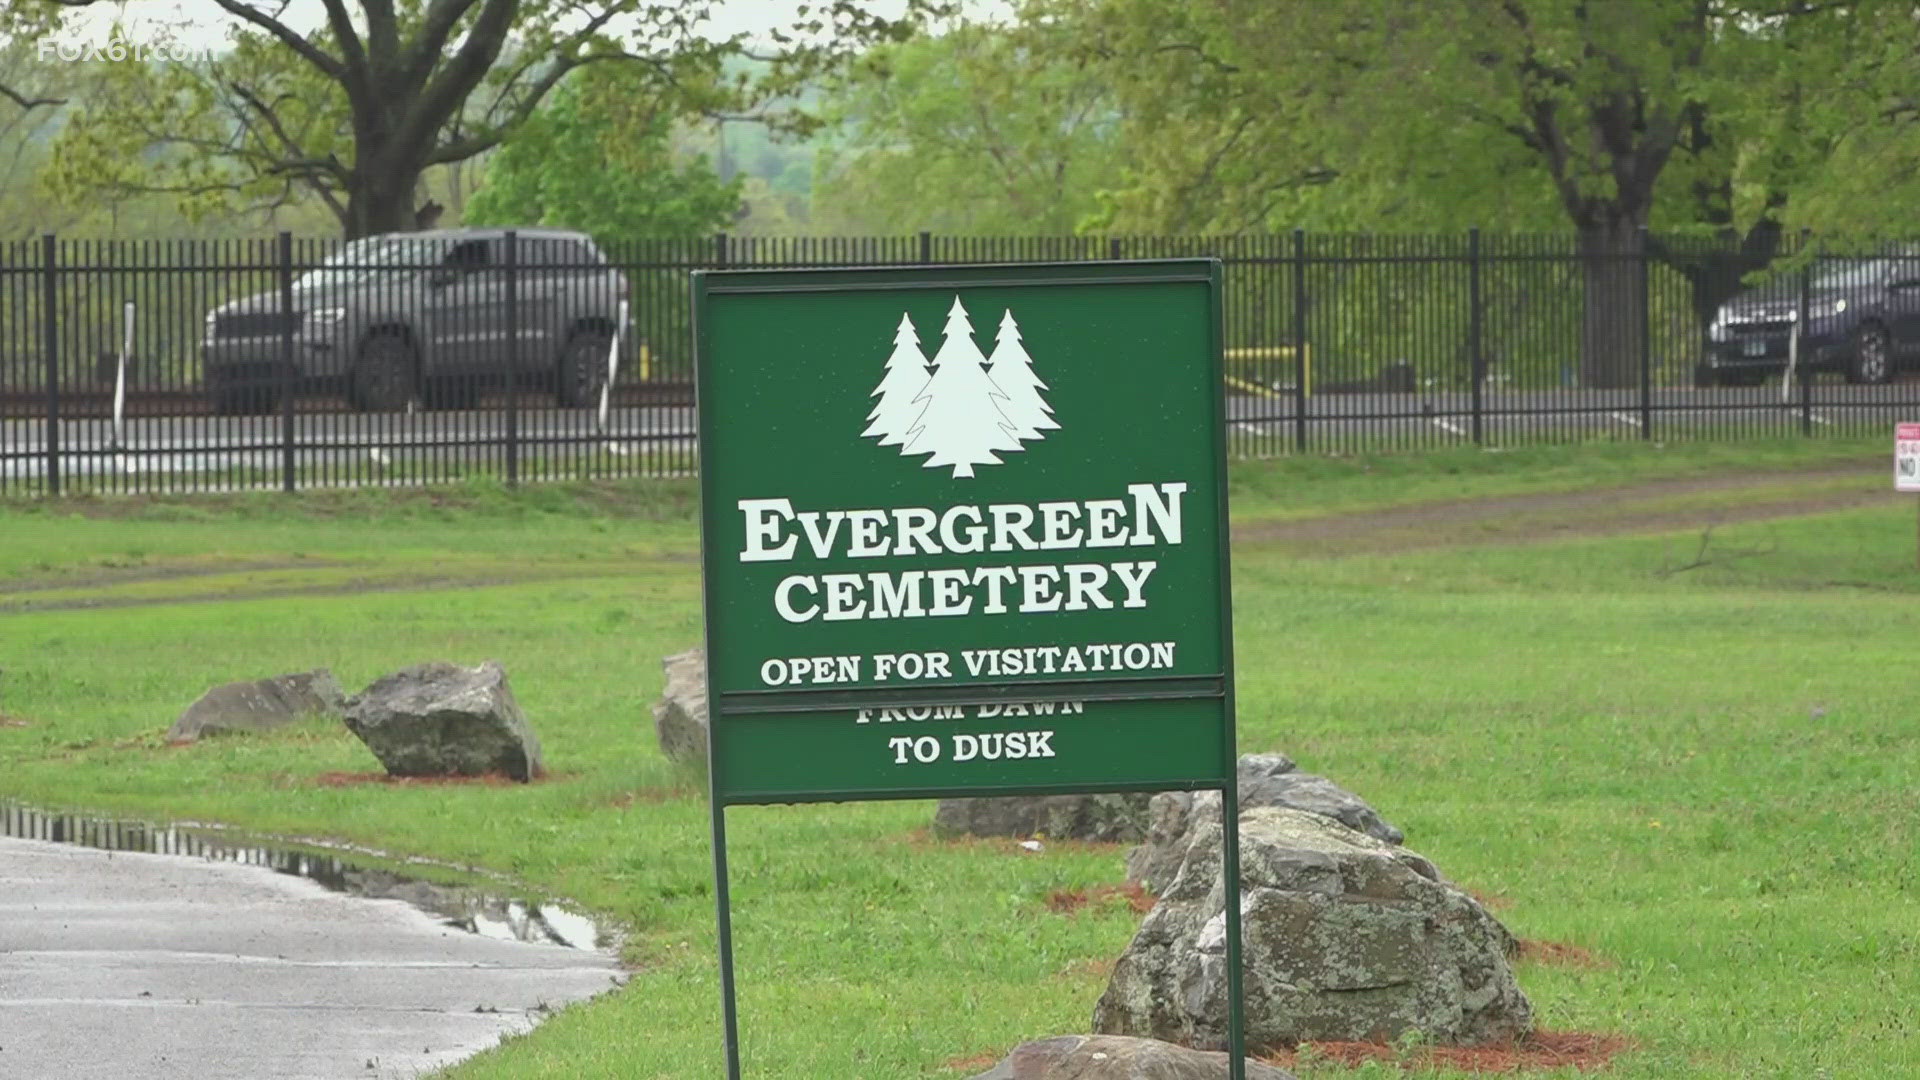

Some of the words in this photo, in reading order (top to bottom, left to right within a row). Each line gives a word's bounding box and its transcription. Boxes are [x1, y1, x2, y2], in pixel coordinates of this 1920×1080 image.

[738, 482, 1187, 562] EVERGREEN
[774, 560, 1157, 623] CEMETERY
[760, 655, 861, 686] OPEN
[873, 651, 952, 681] FOR
[961, 641, 1176, 677] VISITATION
[856, 704, 965, 724] FROM
[977, 700, 1083, 719] DAWN
[888, 736, 941, 764] TO
[952, 730, 1056, 761] DUSK
